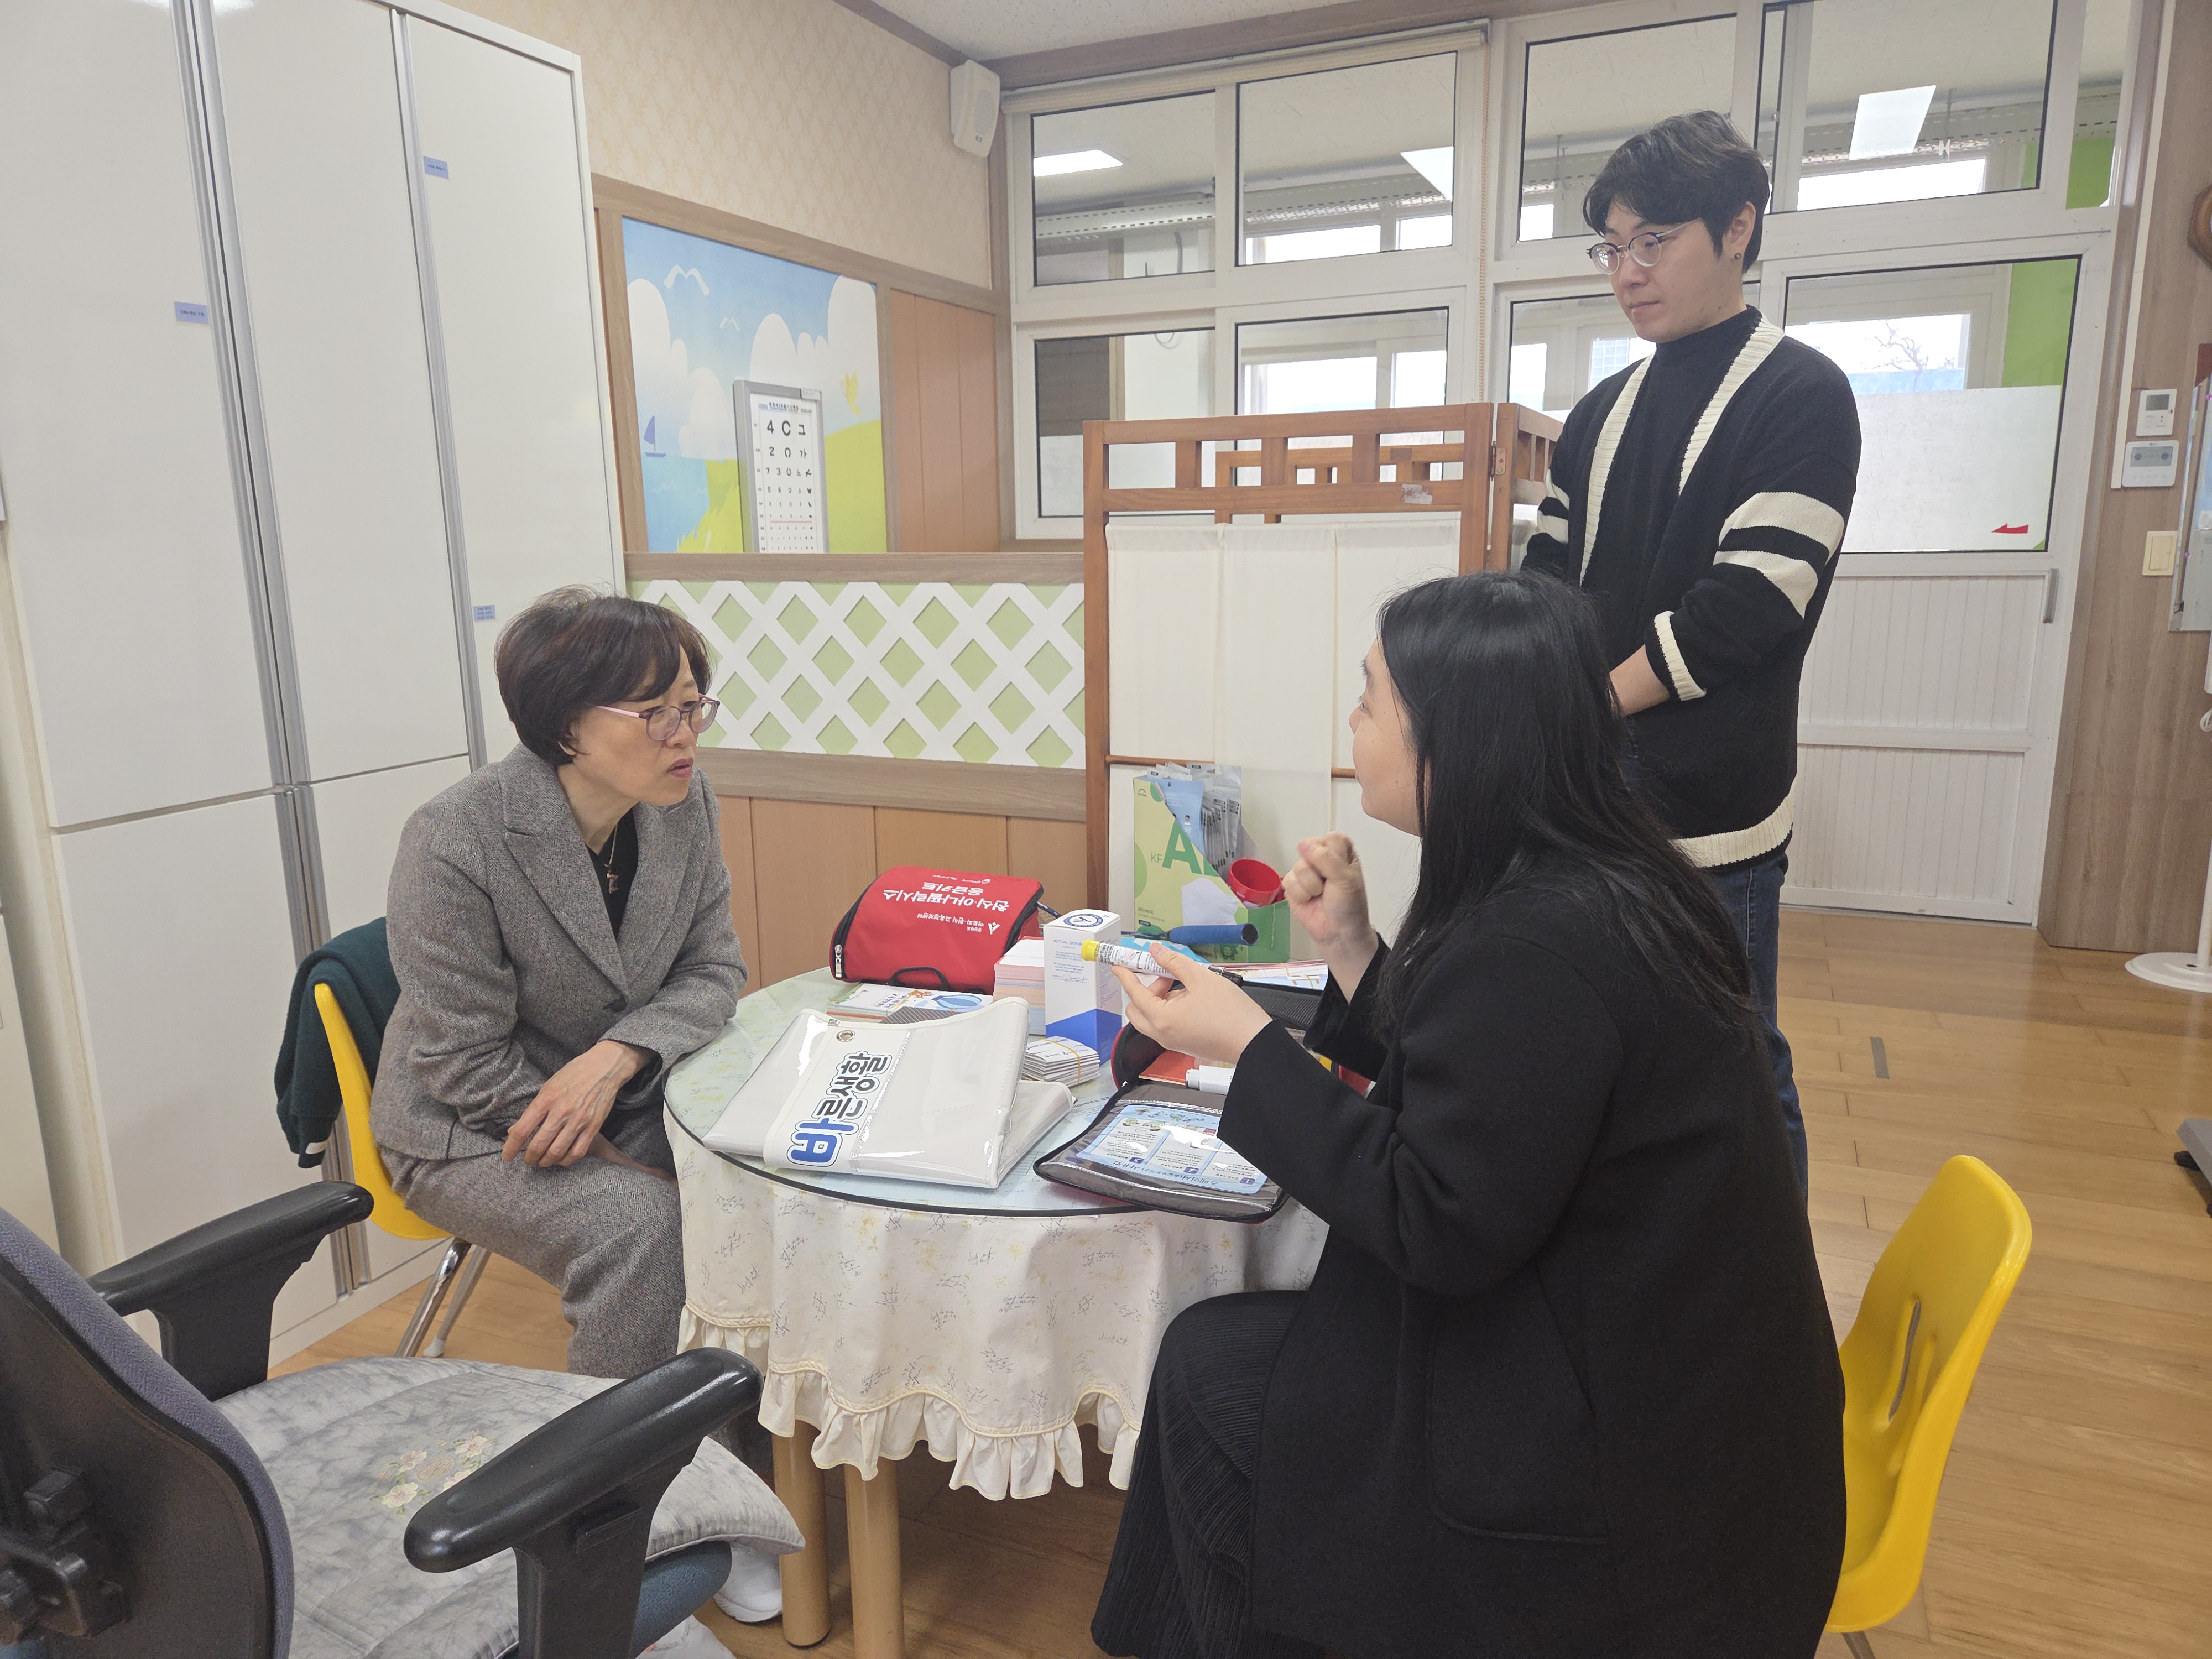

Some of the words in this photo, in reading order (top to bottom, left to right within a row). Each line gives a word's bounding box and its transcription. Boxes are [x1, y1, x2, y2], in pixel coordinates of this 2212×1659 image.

[767, 419, 774, 434] 4
[769, 446, 774, 456] 2
[921, 882, 984, 896] 응급키트
[883, 890, 1009, 912] 천식·아나필락시스
[790, 1053, 888, 1163] 바른생활
